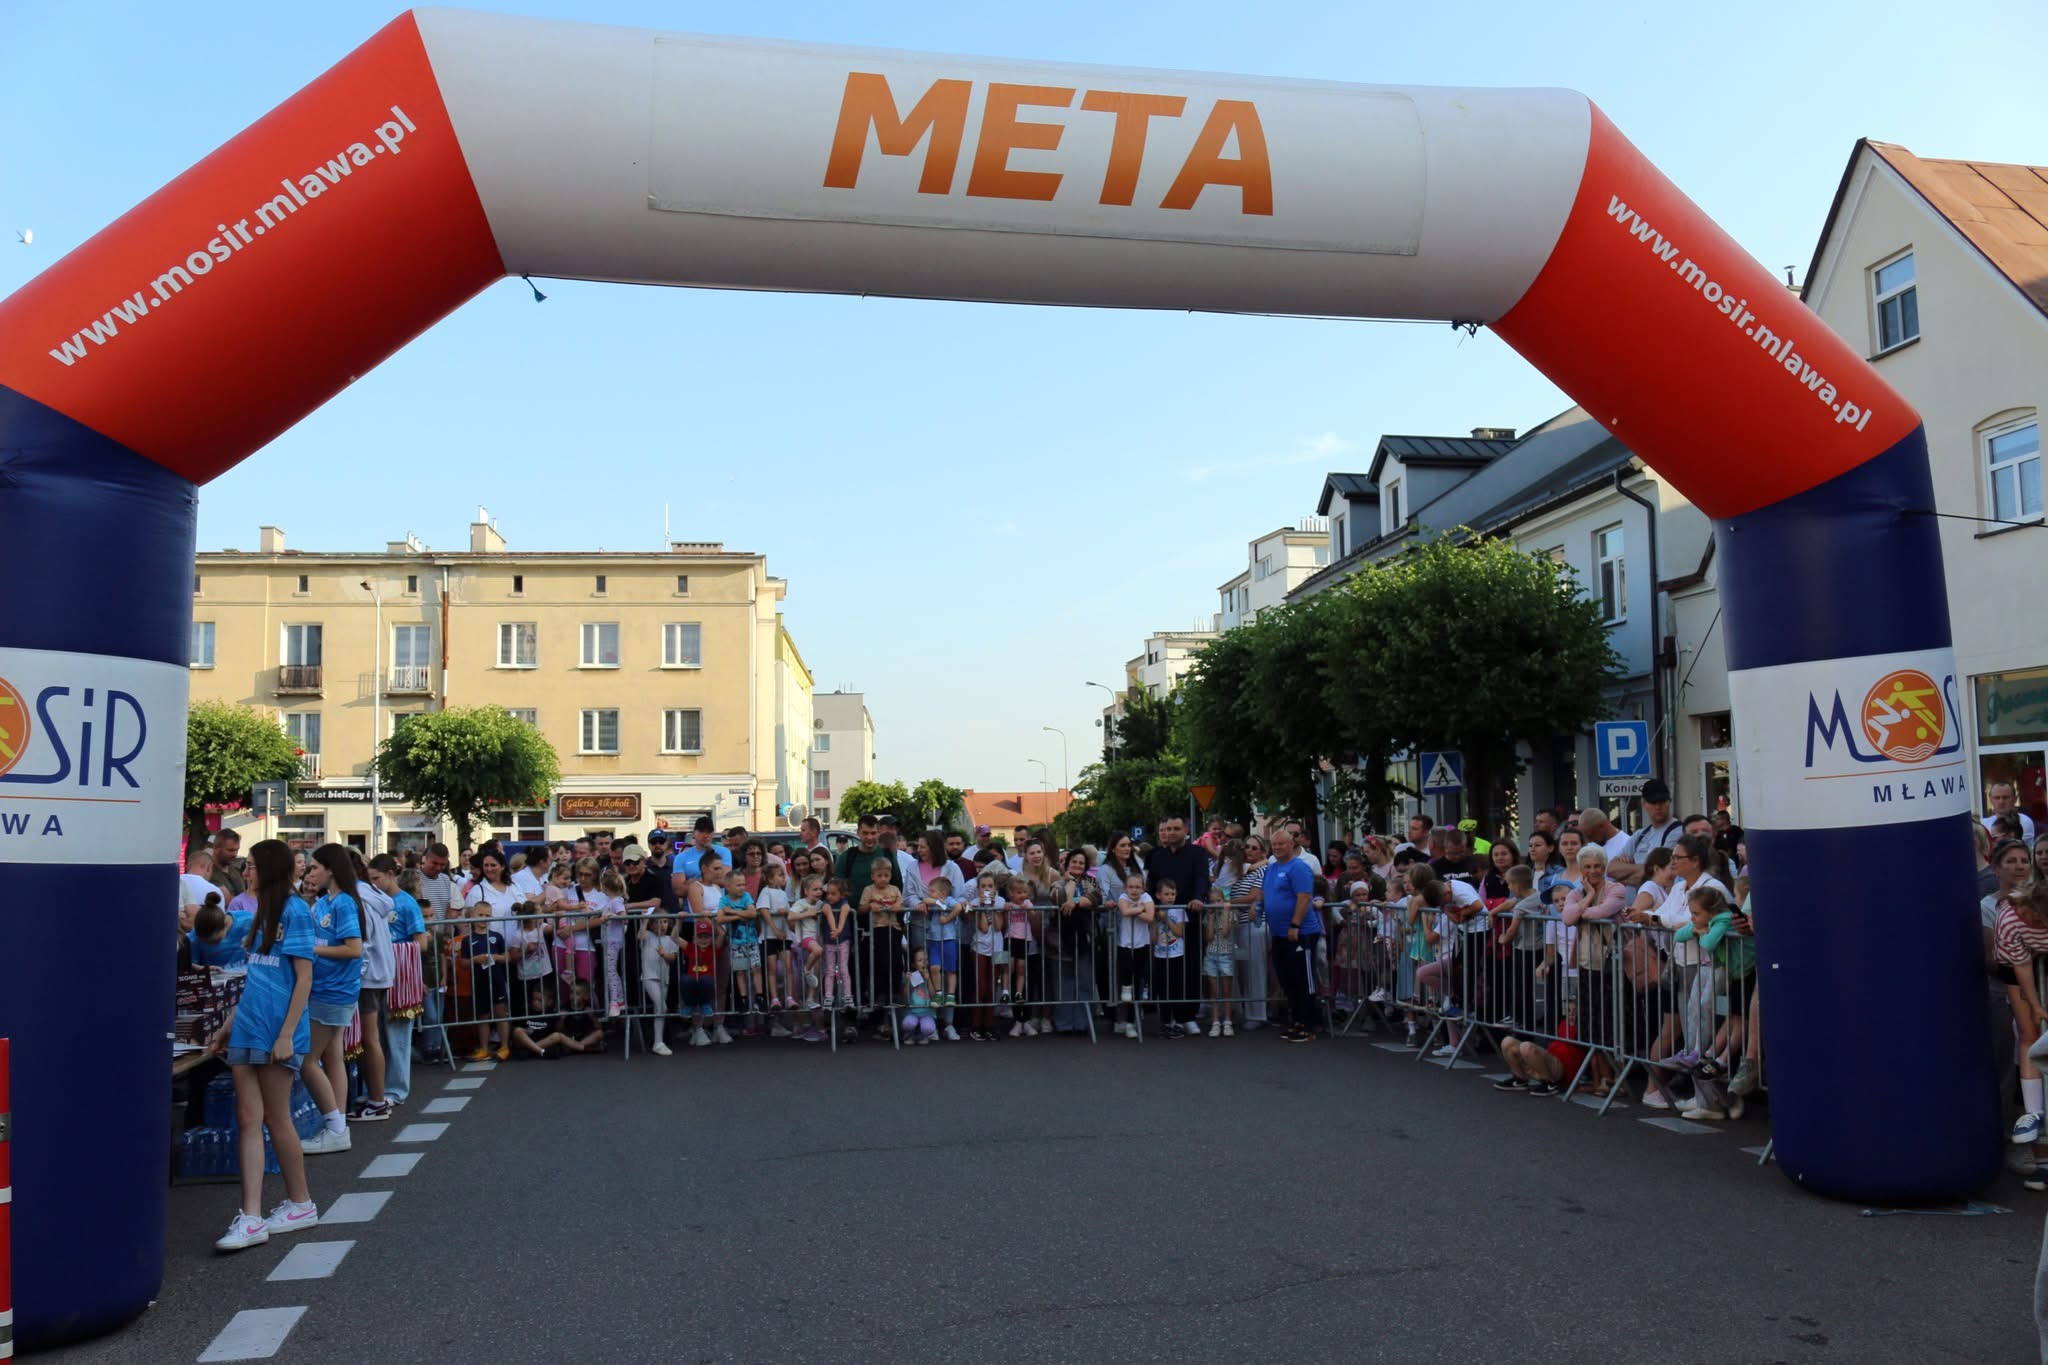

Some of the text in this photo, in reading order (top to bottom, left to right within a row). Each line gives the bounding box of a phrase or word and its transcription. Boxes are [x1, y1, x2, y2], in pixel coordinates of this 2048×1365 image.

[823, 71, 1274, 216] META
[48, 104, 417, 367] www.mosir.mlawa.pl
[1606, 194, 1872, 432] www.mosir.mlawa.pl
[0, 677, 147, 788] SiR
[1607, 727, 1638, 770] P
[304, 789, 326, 799] świat
[328, 789, 365, 800] bielizny
[566, 797, 630, 810] Galeria Alkoholi
[1872, 775, 1966, 803] MŁAWA
